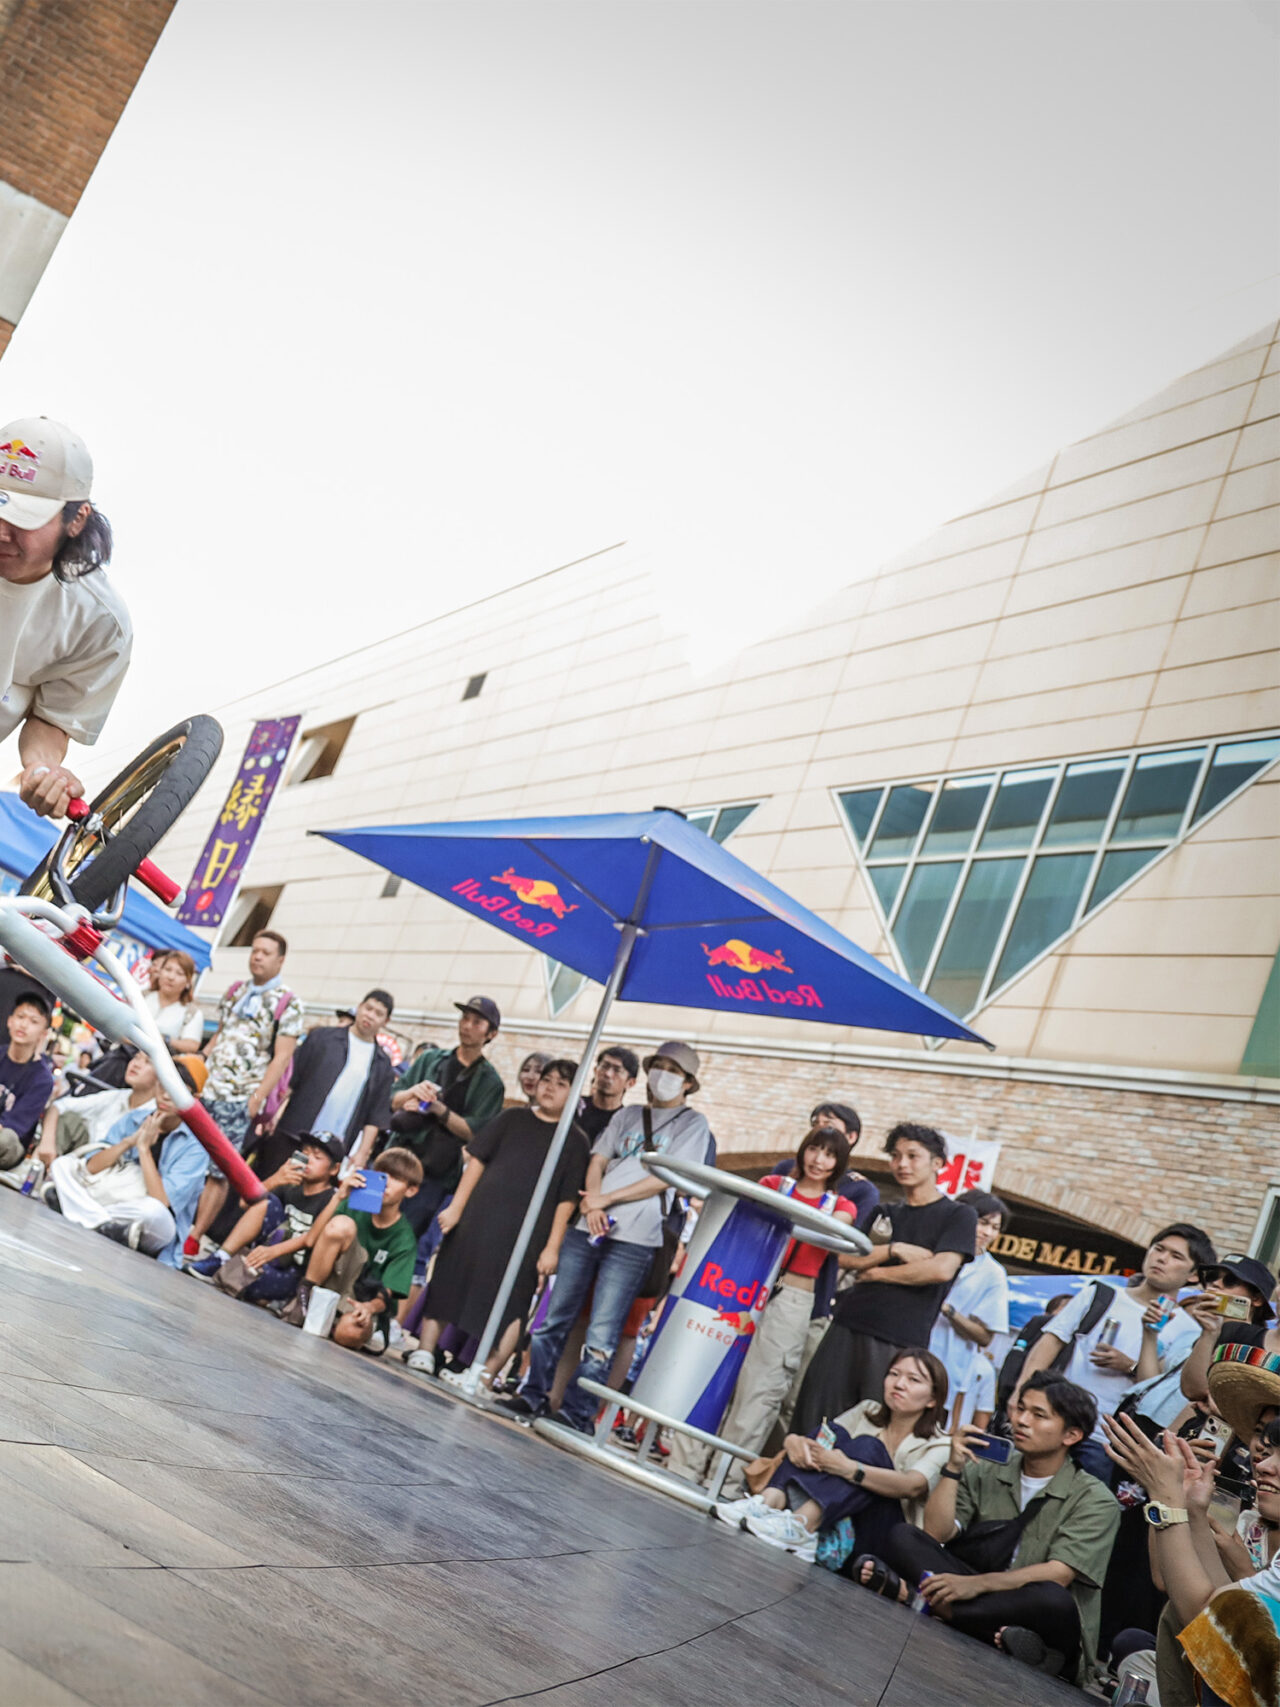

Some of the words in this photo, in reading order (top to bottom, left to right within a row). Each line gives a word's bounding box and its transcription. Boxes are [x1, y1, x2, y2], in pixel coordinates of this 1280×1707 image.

[9, 463, 37, 483] Bull
[201, 773, 267, 890] 縁日
[987, 1234, 1039, 1261] IDE
[1035, 1242, 1120, 1275] MALL
[699, 1261, 759, 1306] Red
